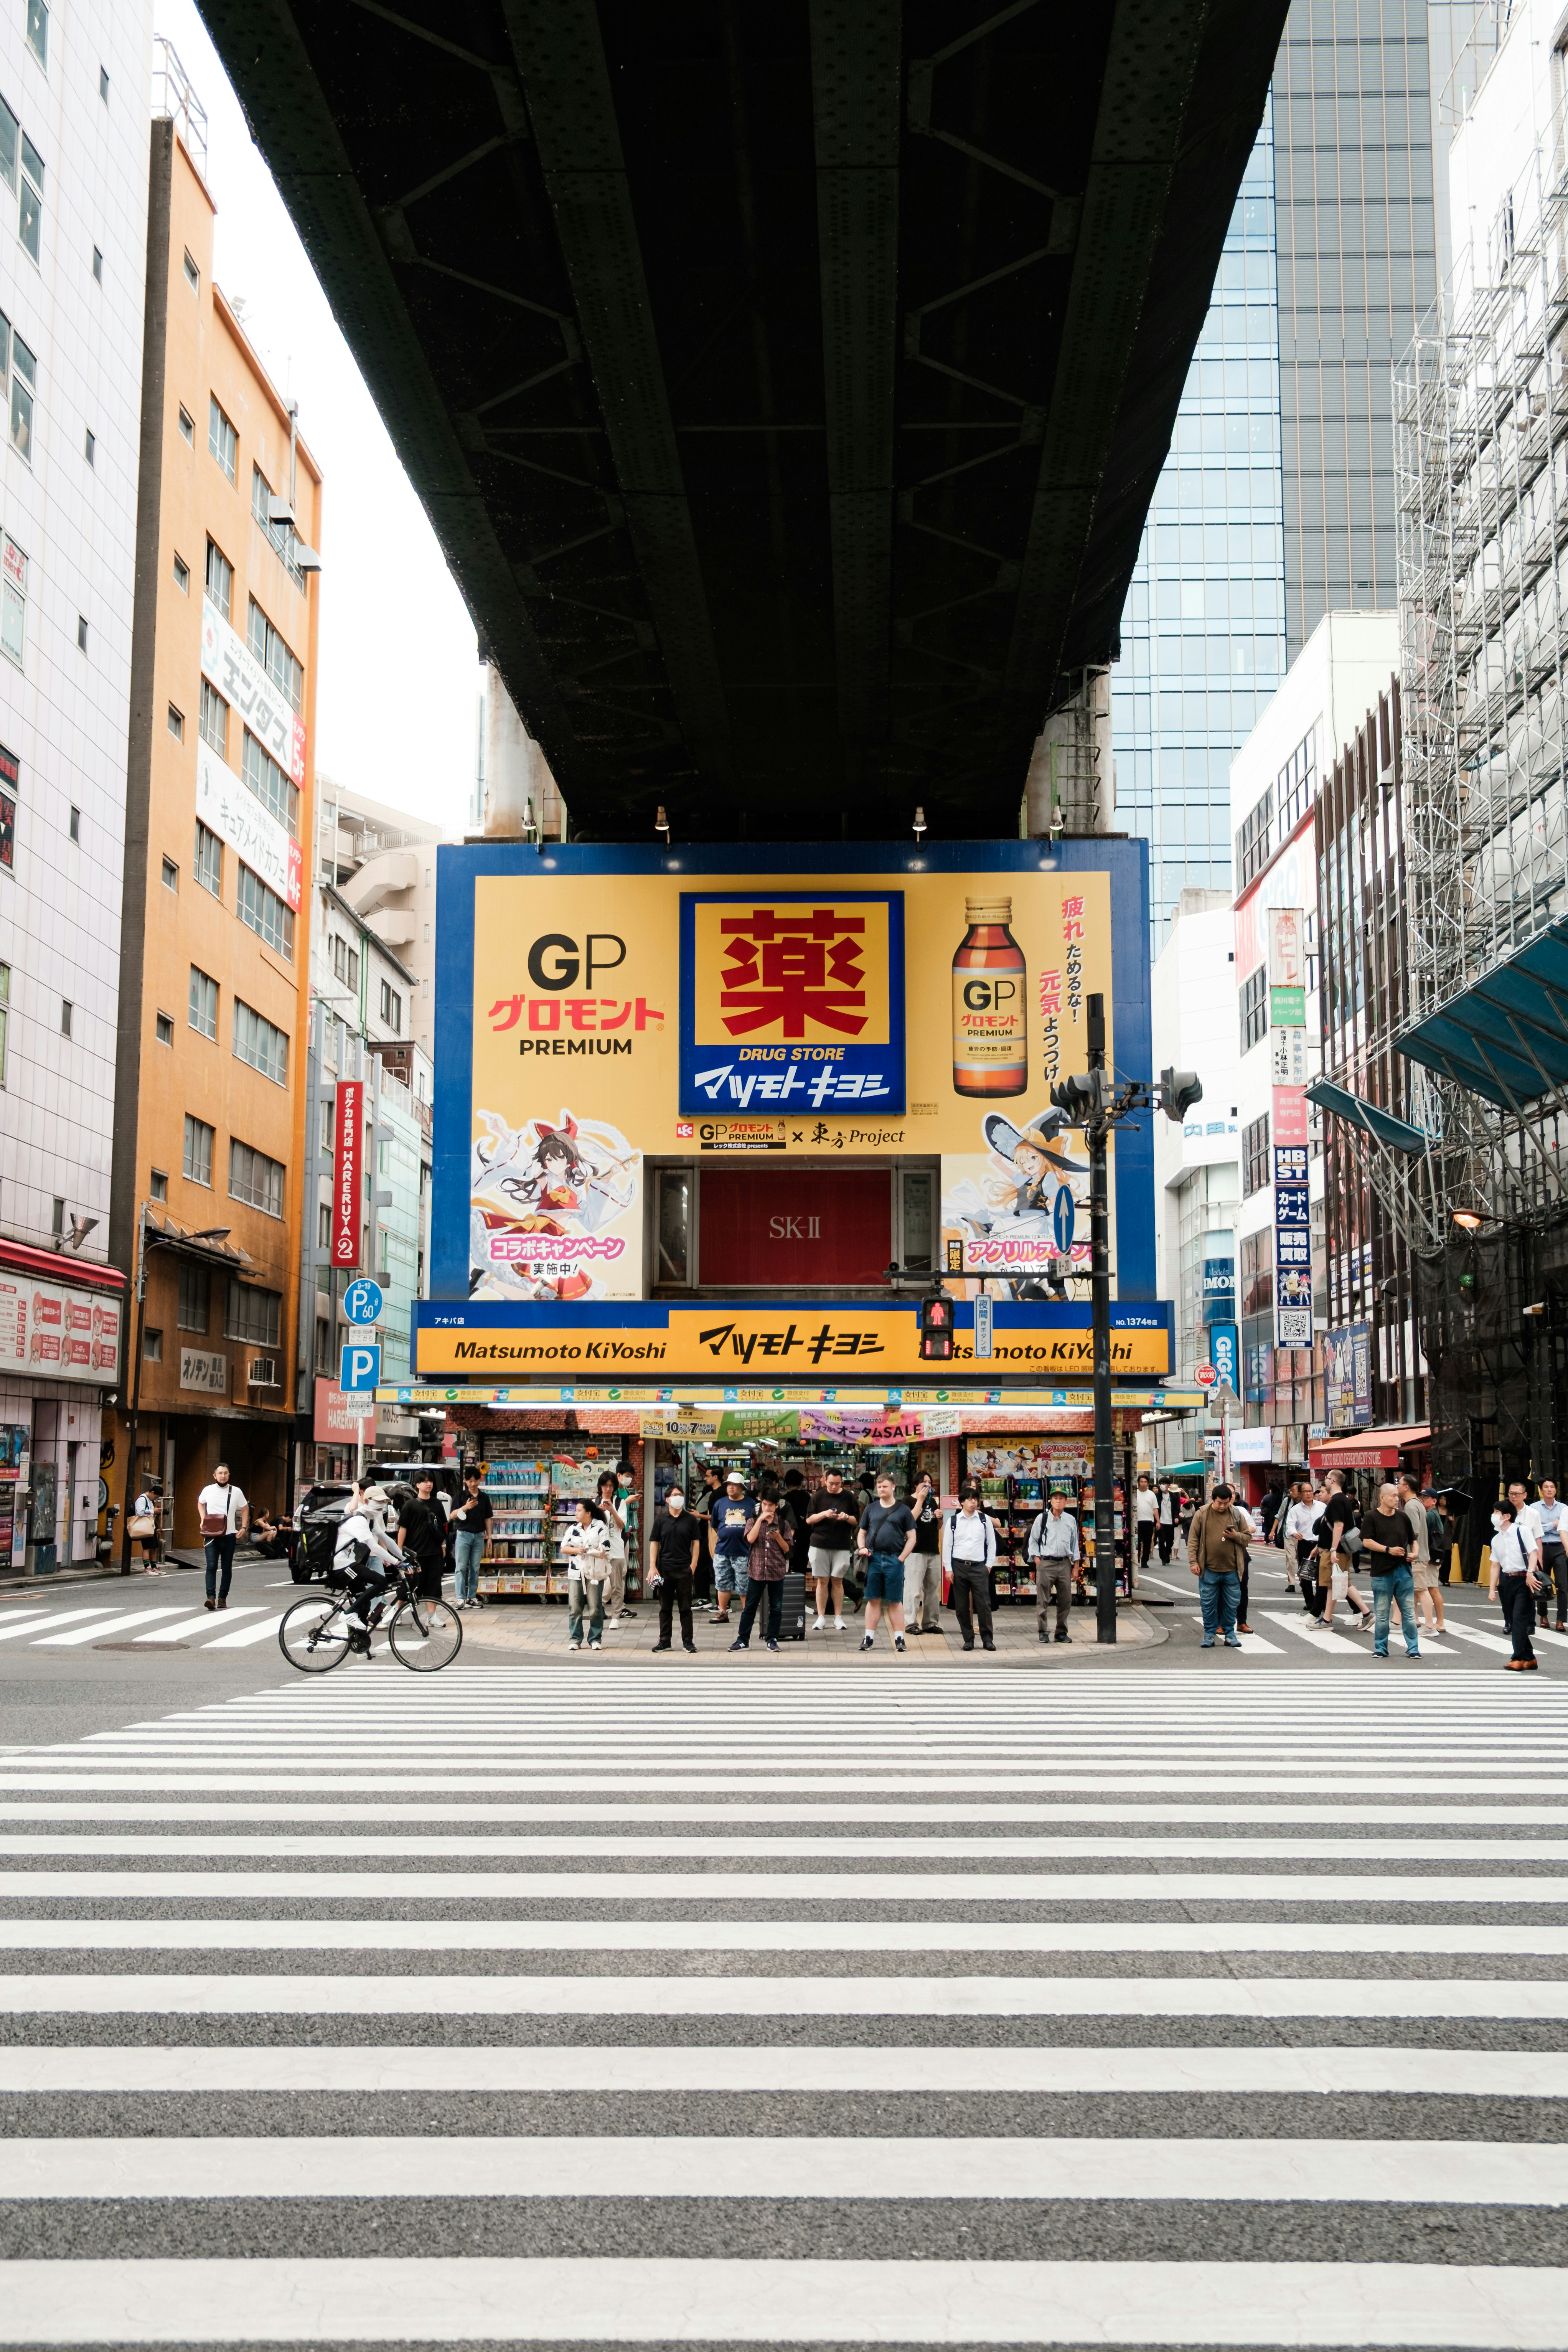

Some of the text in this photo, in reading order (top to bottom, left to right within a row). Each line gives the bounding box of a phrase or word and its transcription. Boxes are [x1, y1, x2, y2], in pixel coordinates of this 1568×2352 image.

[223, 651, 287, 762] エンタス
[293, 719, 306, 742] オノデン
[293, 741, 305, 782] 5F
[221, 798, 285, 885] キュアメイドカフェ
[289, 844, 302, 865] オノデン
[289, 866, 301, 905] 4F
[528, 933, 626, 991] GP
[721, 910, 869, 1037] 薬
[963, 980, 1015, 1011] GP
[488, 994, 664, 1031] グロモント
[961, 1013, 1018, 1027] グロモント
[519, 1039, 631, 1055] PREMIUM
[739, 1047, 845, 1061] DRUG STORE
[695, 1065, 890, 1108] マツモトキヨシ
[344, 1087, 354, 1147] ポケカ専門店
[700, 1124, 727, 1140] GP
[729, 1123, 773, 1133] グロモント
[811, 1122, 905, 1149] 東方 Project
[1184, 1121, 1225, 1137] 内田
[1277, 1150, 1306, 1163] HB
[1278, 1165, 1306, 1178] ST
[338, 1150, 353, 1258] HARERUYA 2
[1278, 1191, 1306, 1205] カード
[1278, 1207, 1307, 1221] ゲーム
[1279, 1232, 1307, 1246] 販売
[492, 1239, 623, 1258] コラボキャンペーン
[968, 1241, 1091, 1263] アクリルスン
[1280, 1247, 1307, 1262] 買取
[950, 1249, 961, 1270] 限定
[1059, 1260, 1070, 1273] 8-20
[533, 1262, 579, 1276] 実施中!
[1209, 1267, 1229, 1276] Models
[352, 1290, 379, 1318] P 60 分
[978, 1300, 989, 1319] 夜間
[434, 1316, 465, 1325] アキバ店
[1116, 1317, 1158, 1326] NO.1374号店
[454, 1342, 667, 1359] Matsumoto KiYoshi
[699, 1323, 885, 1364] マツモトキヨシ
[918, 1343, 1132, 1360] tsmoto KiYohi
[183, 1356, 209, 1382] オノデン
[351, 1350, 373, 1387] P
[1081, 1365, 1159, 1373] 照明用しております。
[1216, 1336, 1233, 1387] GiGO
[744, 1419, 775, 1428] 扫码有礼
[837, 1424, 921, 1438] オータムSALE
[1040, 1445, 1087, 1453] アクリルスタンド
[1321, 1451, 1381, 1466] TOKYO RADIO DEPARTMENT STORE
